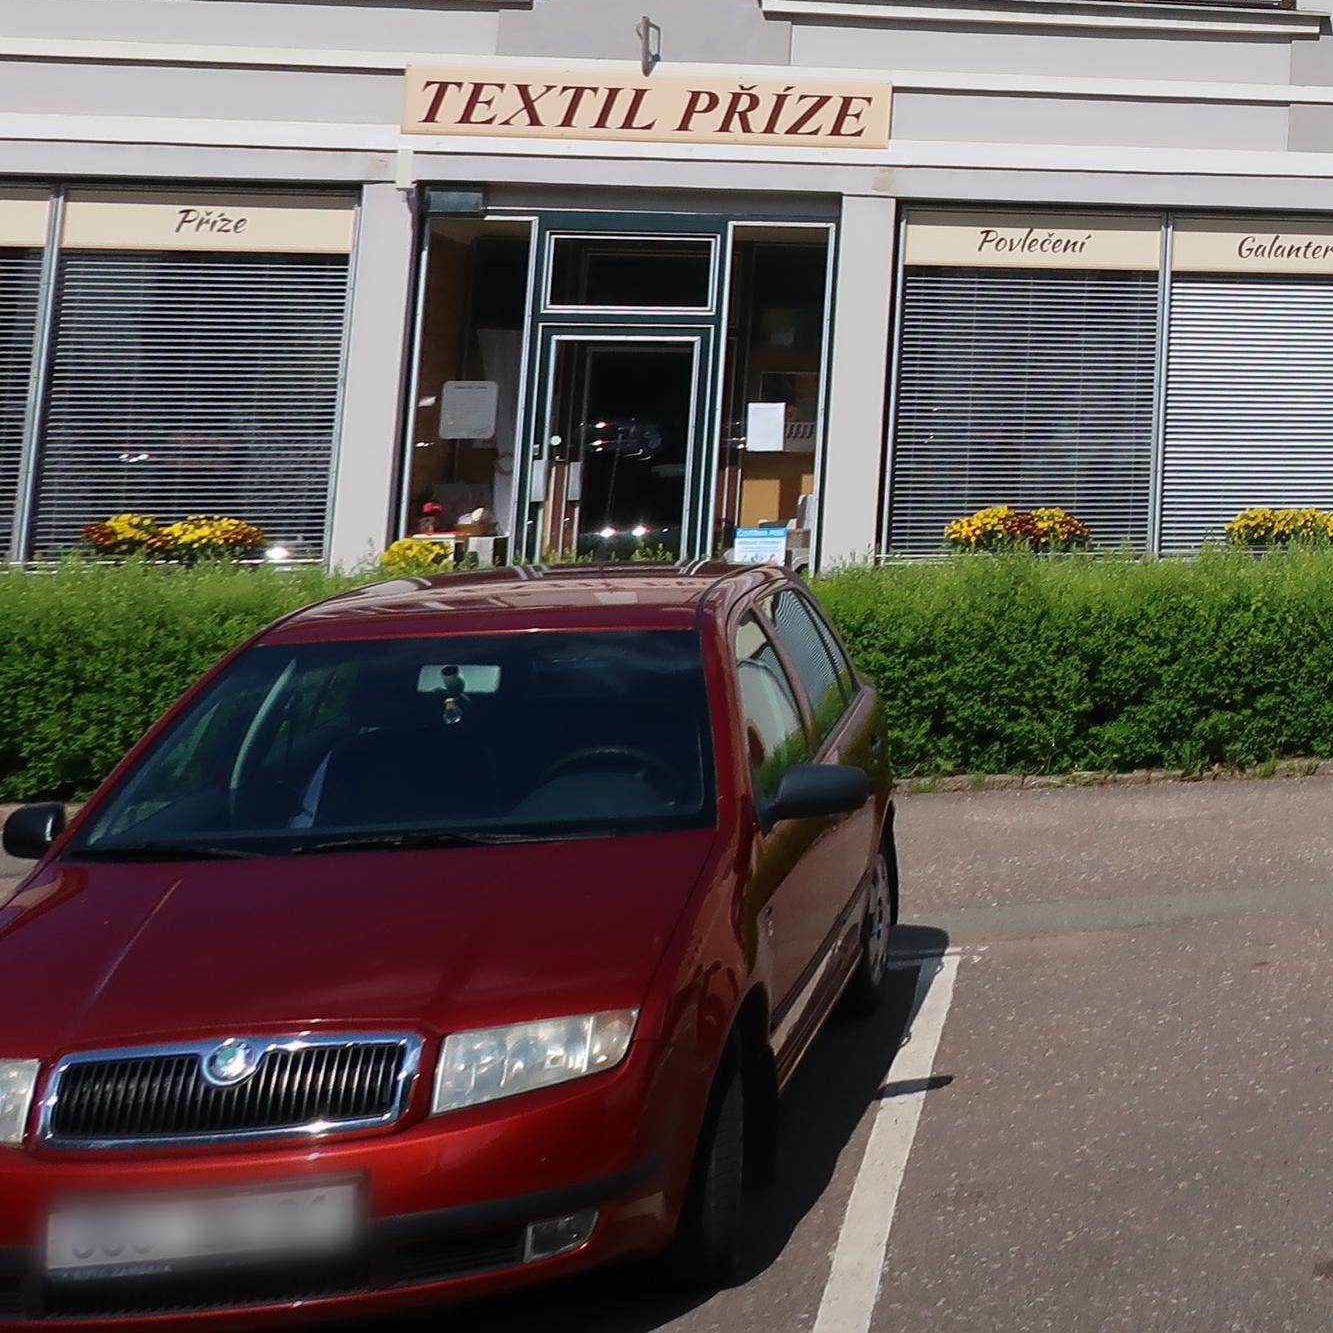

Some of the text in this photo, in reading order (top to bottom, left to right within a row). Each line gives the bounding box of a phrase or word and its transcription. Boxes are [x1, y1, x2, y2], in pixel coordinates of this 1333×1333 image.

[417, 80, 873, 137] TEXTIL PŘÍZE
[174, 208, 249, 234] Příze
[977, 227, 1092, 254] Povlečení
